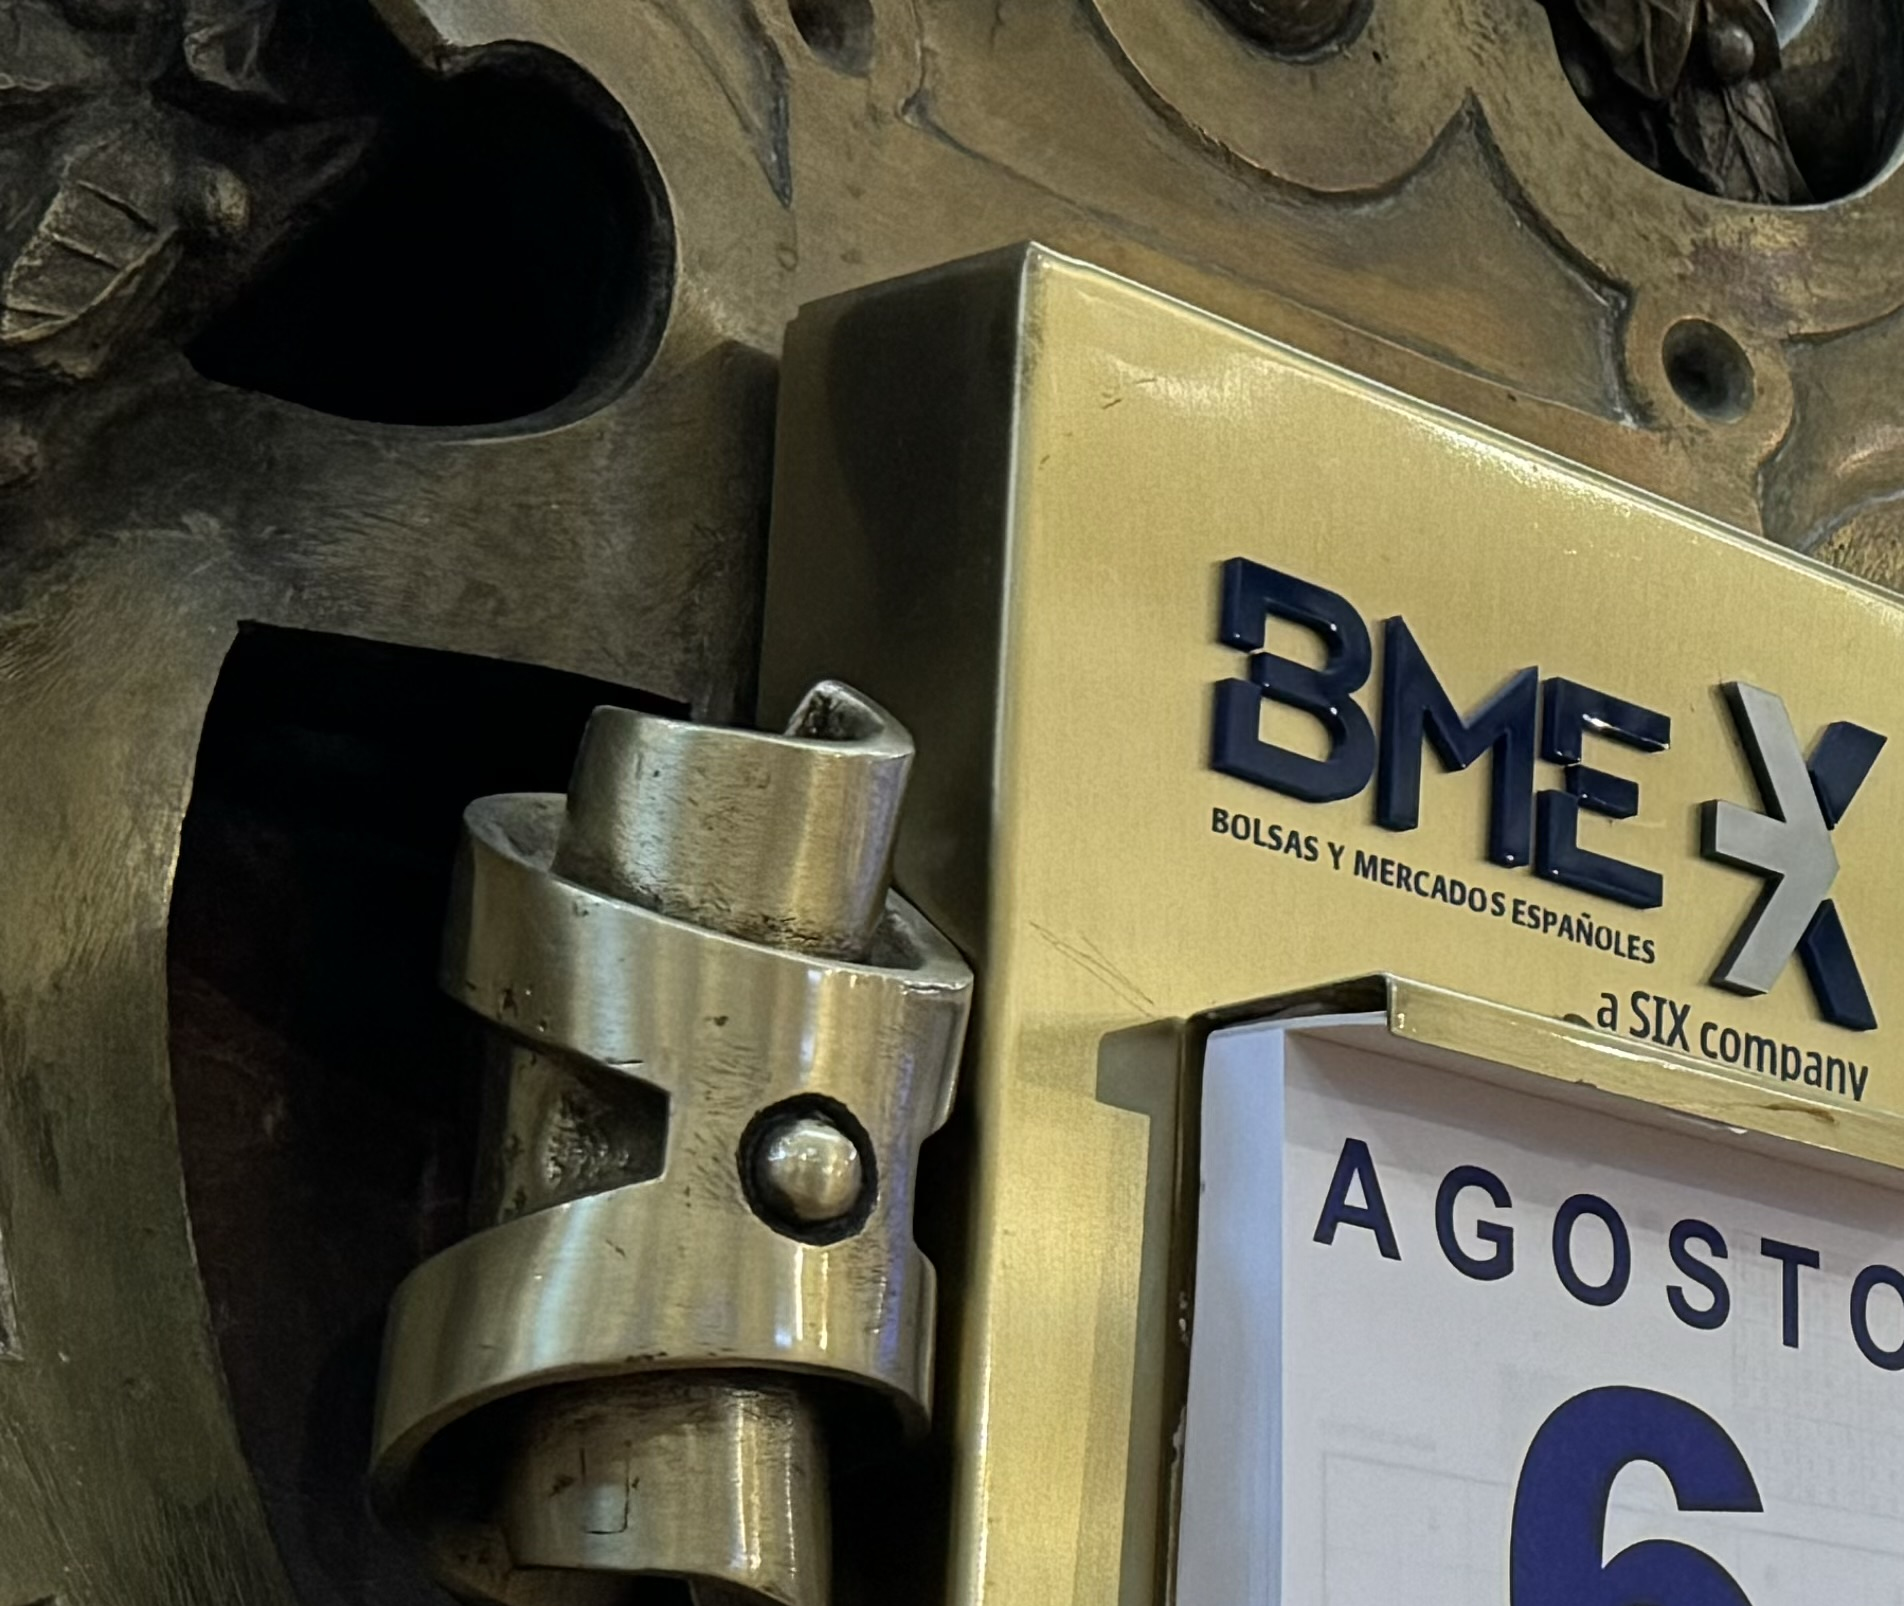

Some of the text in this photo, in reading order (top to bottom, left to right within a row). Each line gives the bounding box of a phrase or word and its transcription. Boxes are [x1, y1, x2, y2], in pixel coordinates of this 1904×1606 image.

[1209, 556, 1671, 909] BME
[1212, 807, 1656, 964] BOLSAS Y MERCADOS ESPAÑOLES
[1597, 991, 1869, 1101] a SIX company
